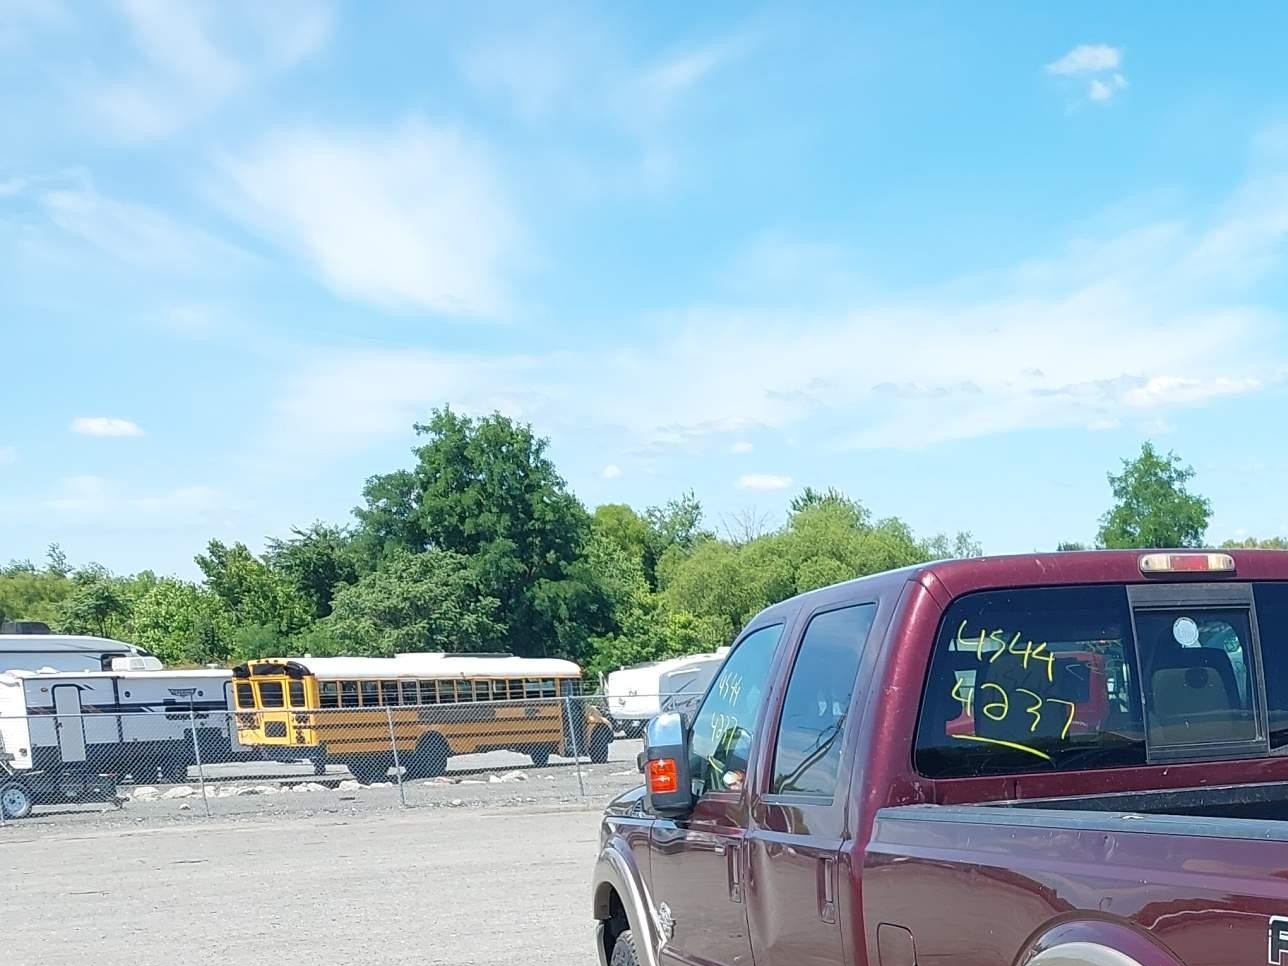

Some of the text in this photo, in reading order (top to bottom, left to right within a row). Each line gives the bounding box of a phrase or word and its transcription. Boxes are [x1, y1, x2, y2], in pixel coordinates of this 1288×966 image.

[958, 619, 1055, 683] 4544
[719, 670, 744, 708] 4544
[951, 677, 1076, 740] 4237
[711, 711, 738, 757] 4237
